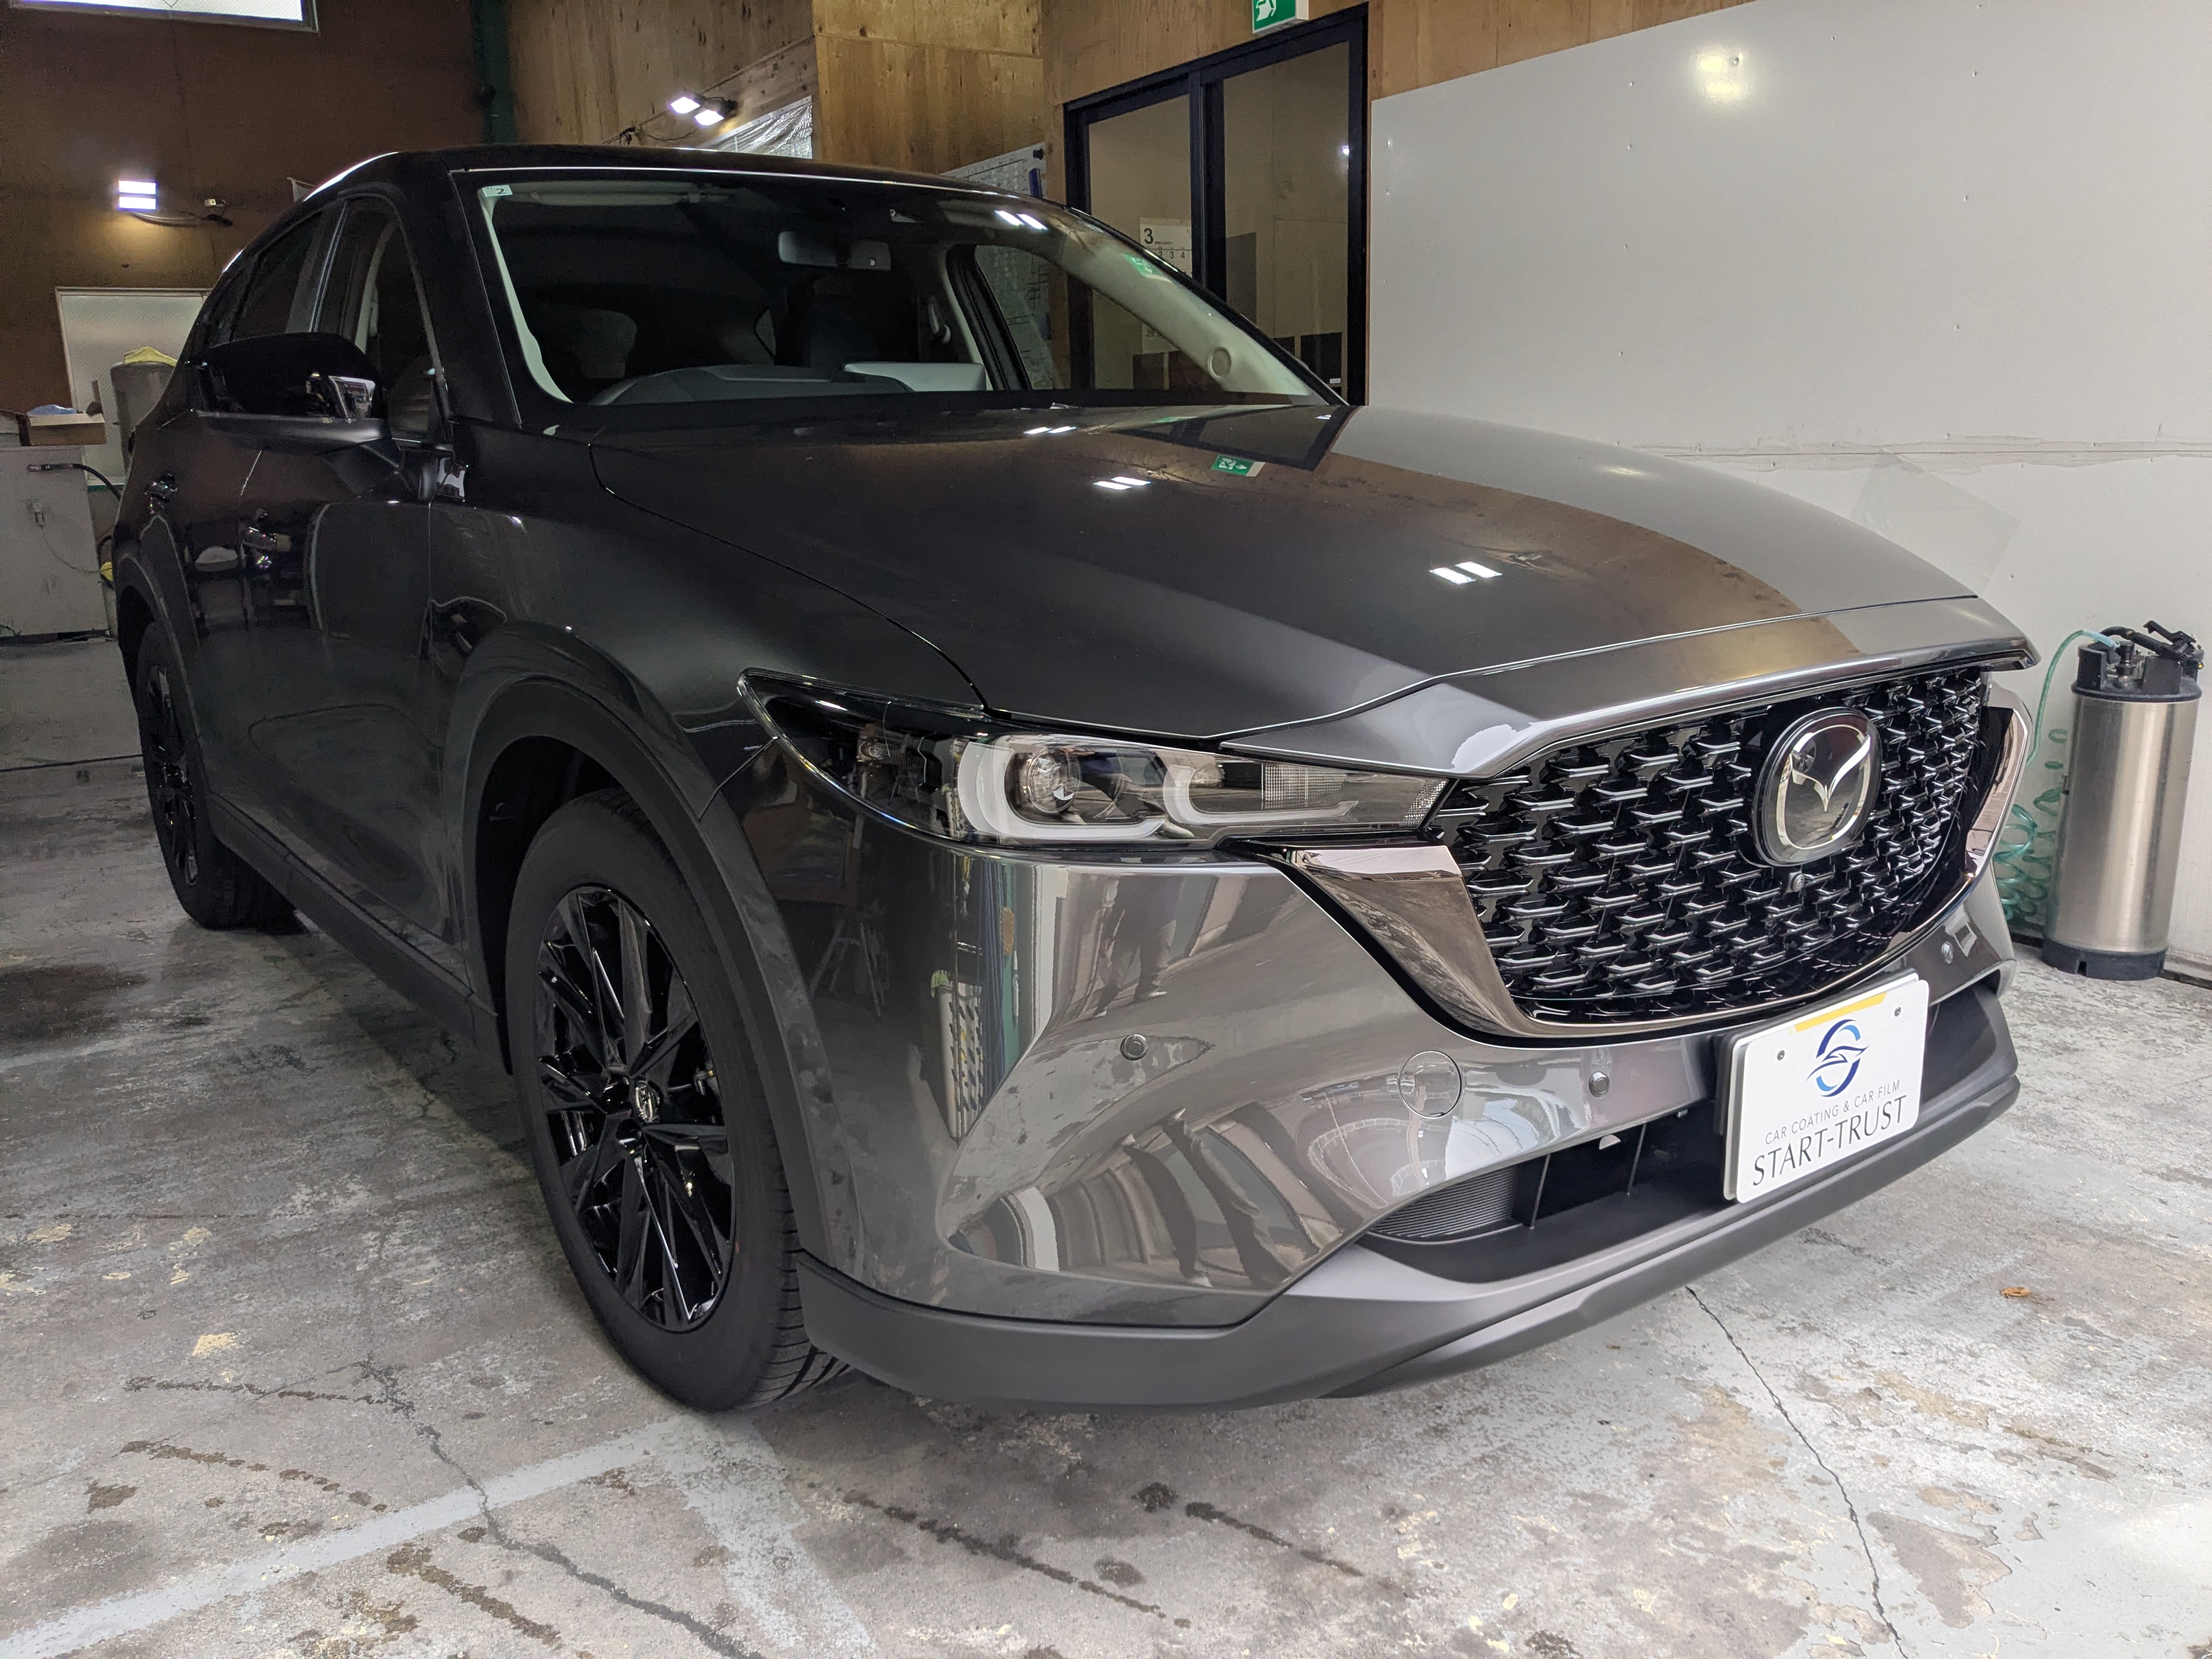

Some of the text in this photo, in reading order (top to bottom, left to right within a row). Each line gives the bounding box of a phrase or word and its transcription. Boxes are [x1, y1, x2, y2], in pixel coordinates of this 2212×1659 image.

[1143, 228, 1154, 245] 3
[1752, 1094, 1907, 1187] START-TRUST
[1765, 1080, 1900, 1145] CAR COATING & CAR FILM
